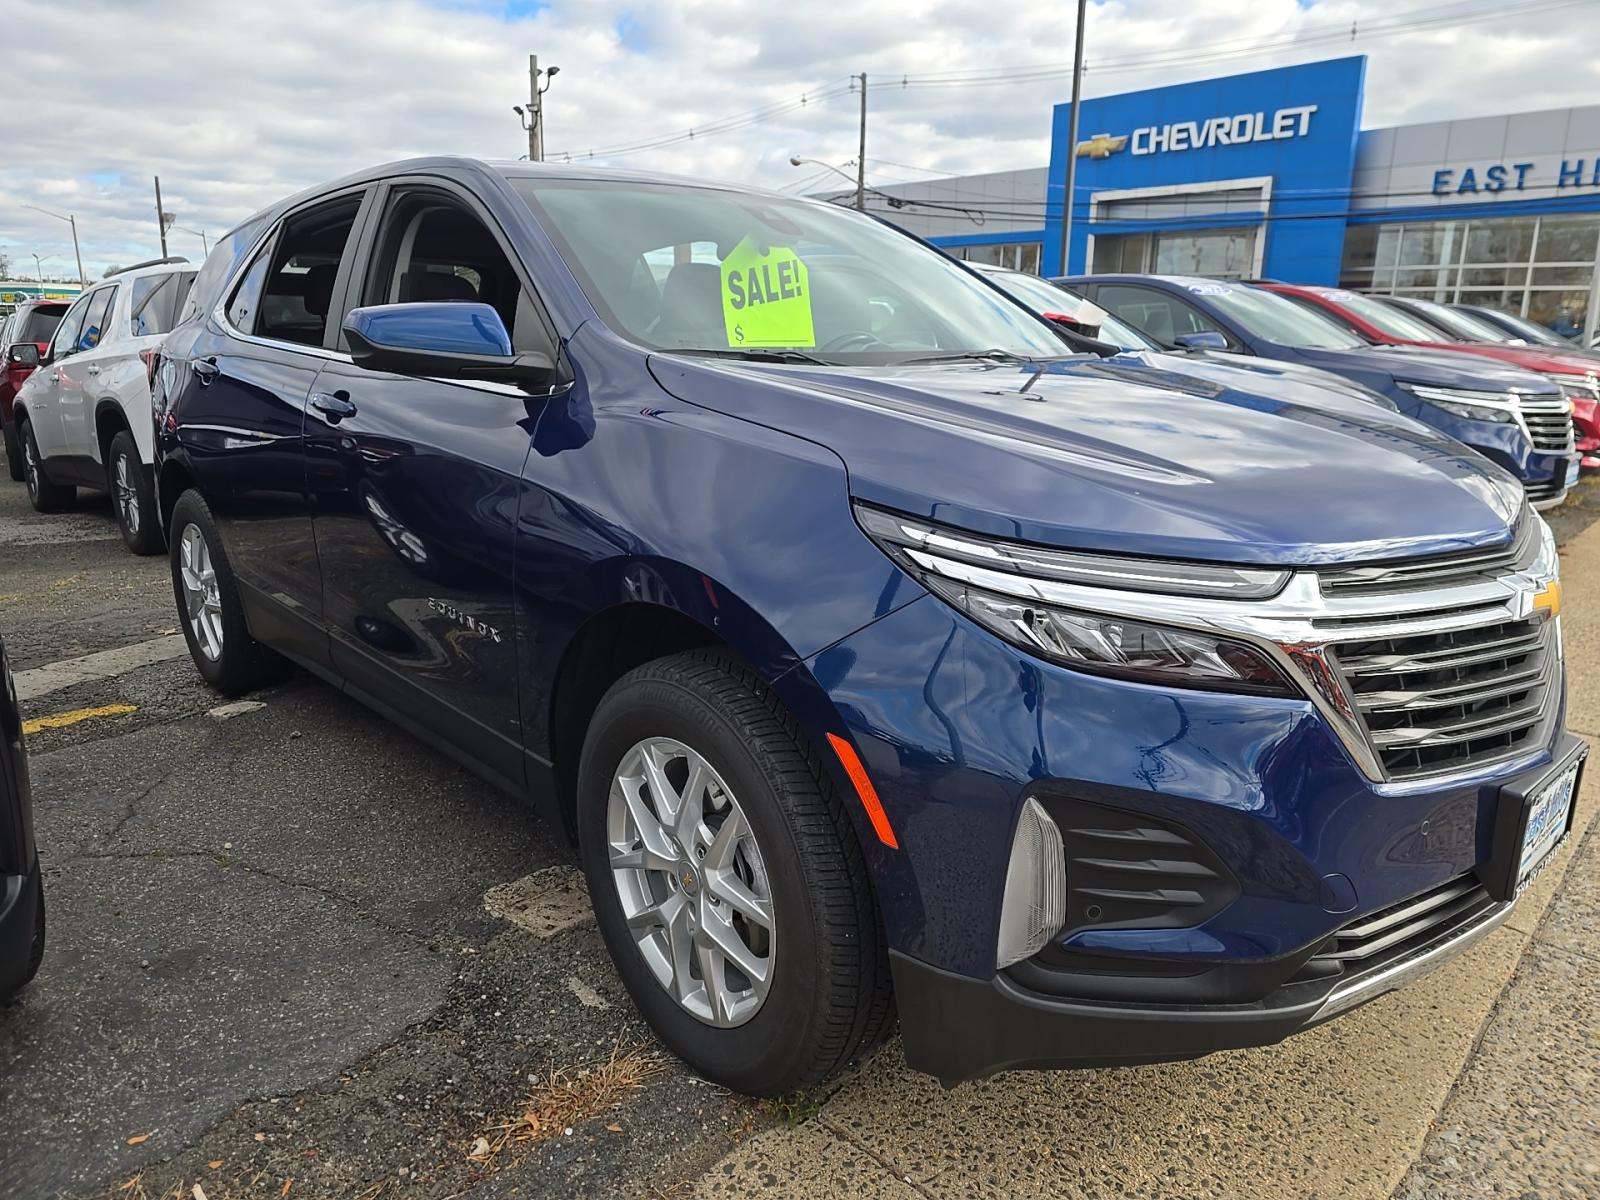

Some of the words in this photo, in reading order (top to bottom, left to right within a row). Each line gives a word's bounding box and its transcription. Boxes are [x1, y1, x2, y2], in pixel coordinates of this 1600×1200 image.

[1131, 105, 1317, 155] CHEVROLET
[1432, 163, 1534, 195] EAST
[728, 259, 802, 310] SALE!
[734, 323, 745, 344] $
[428, 597, 501, 643] EQUINOX
